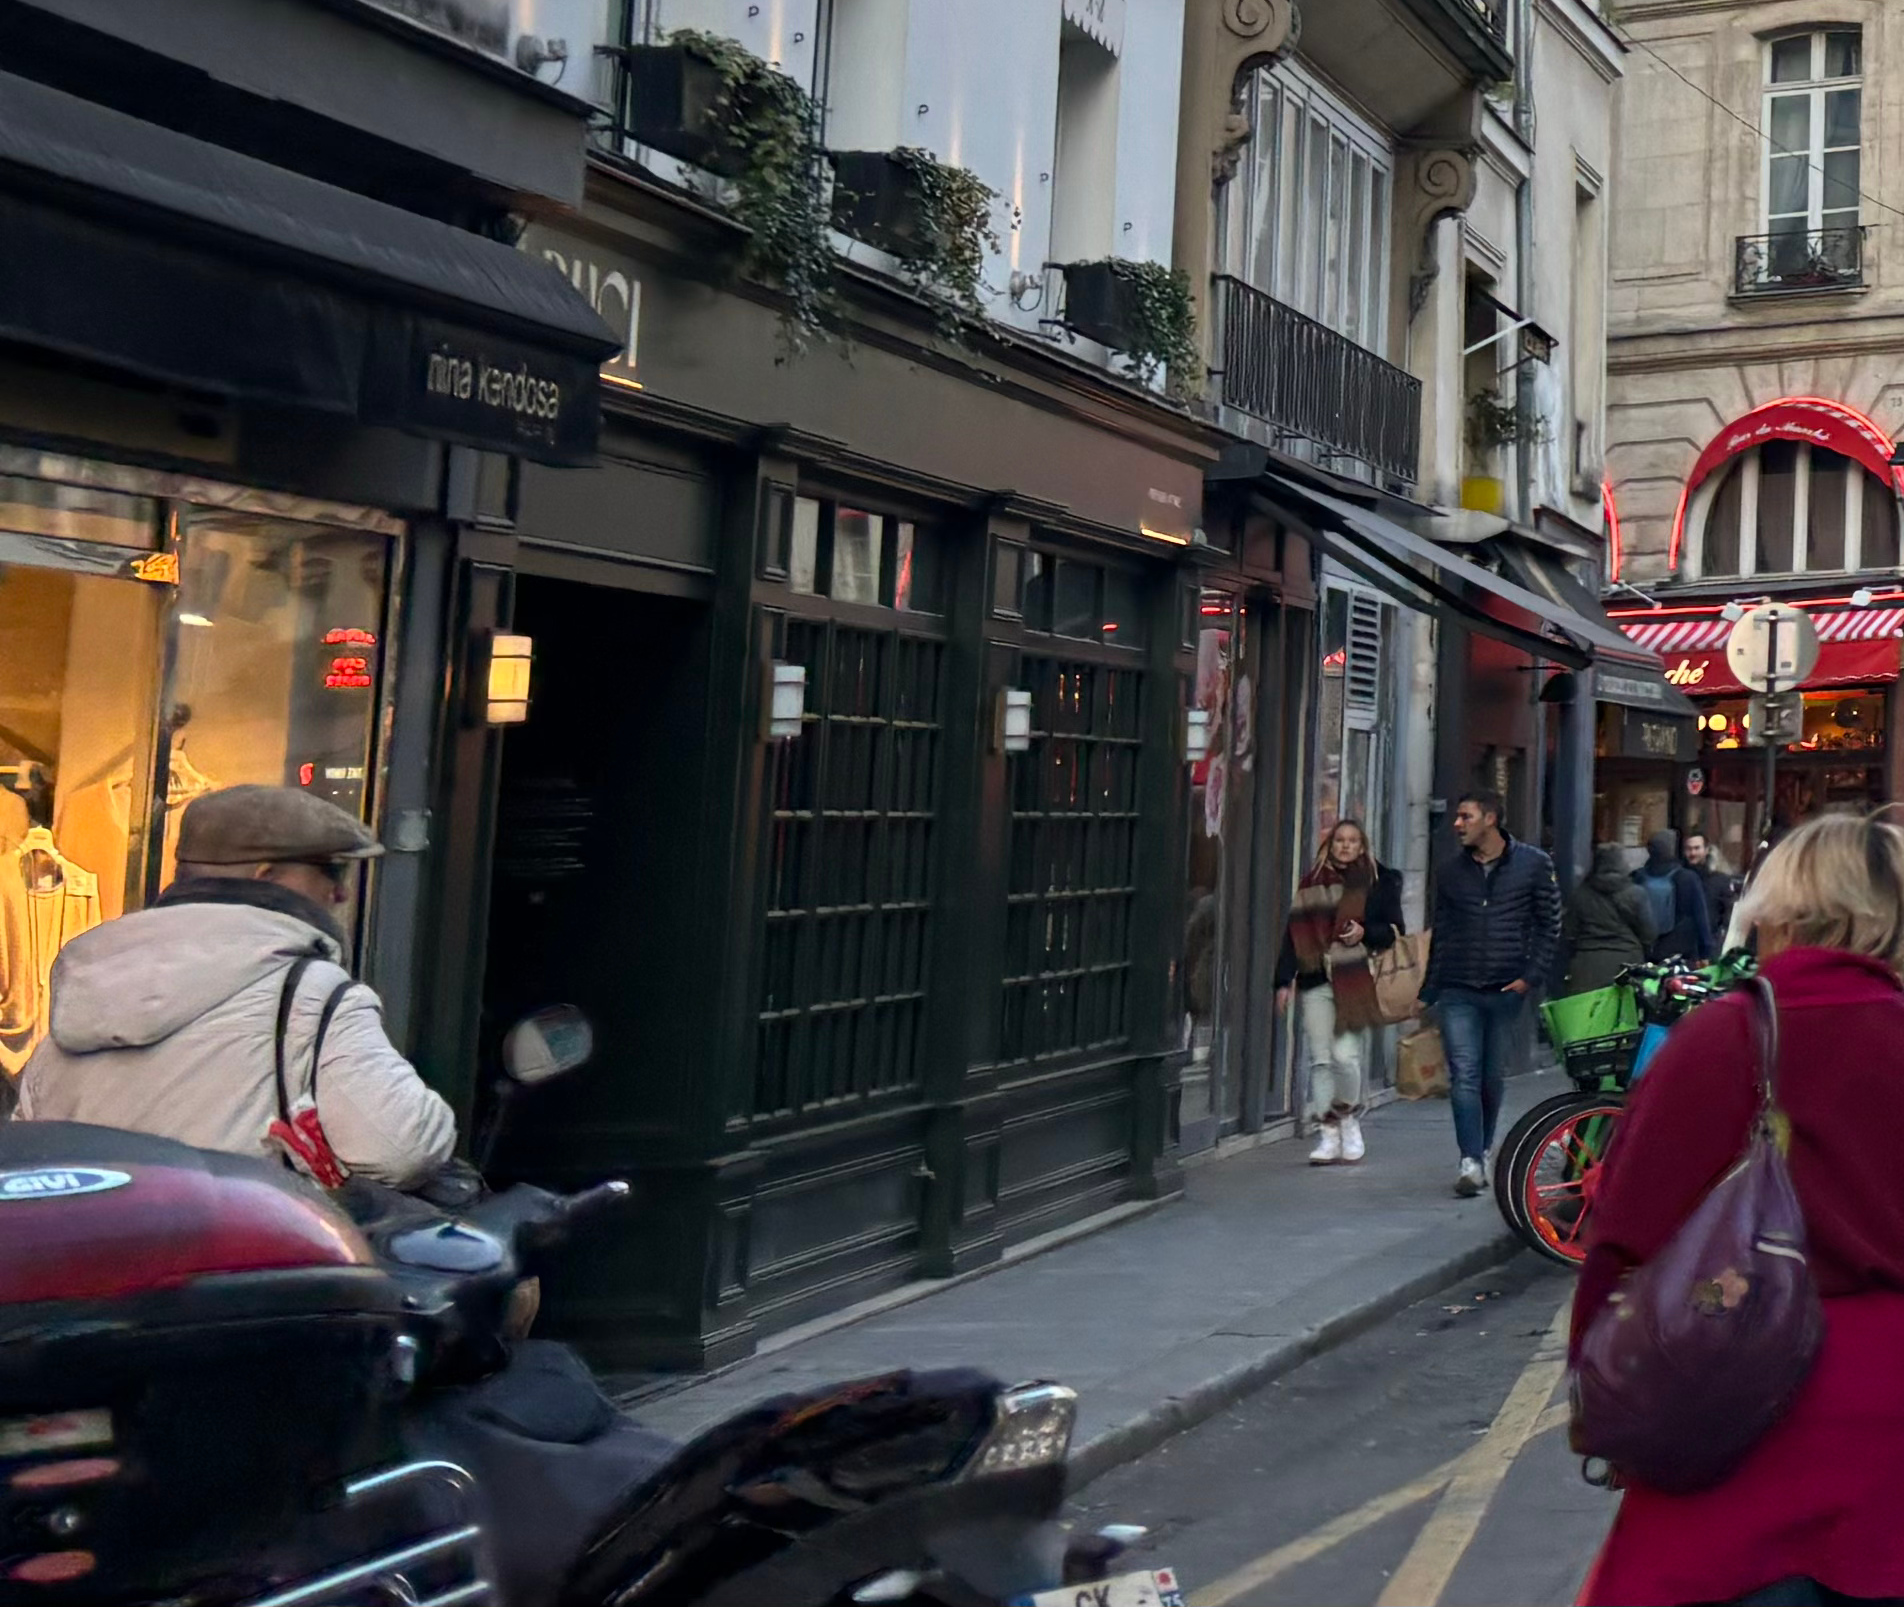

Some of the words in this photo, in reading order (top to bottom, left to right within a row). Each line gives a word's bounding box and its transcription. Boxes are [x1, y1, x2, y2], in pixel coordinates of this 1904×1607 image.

[427, 343, 473, 399] nina
[478, 360, 559, 419] kendosa
[4, 1174, 80, 1192] GIVI
